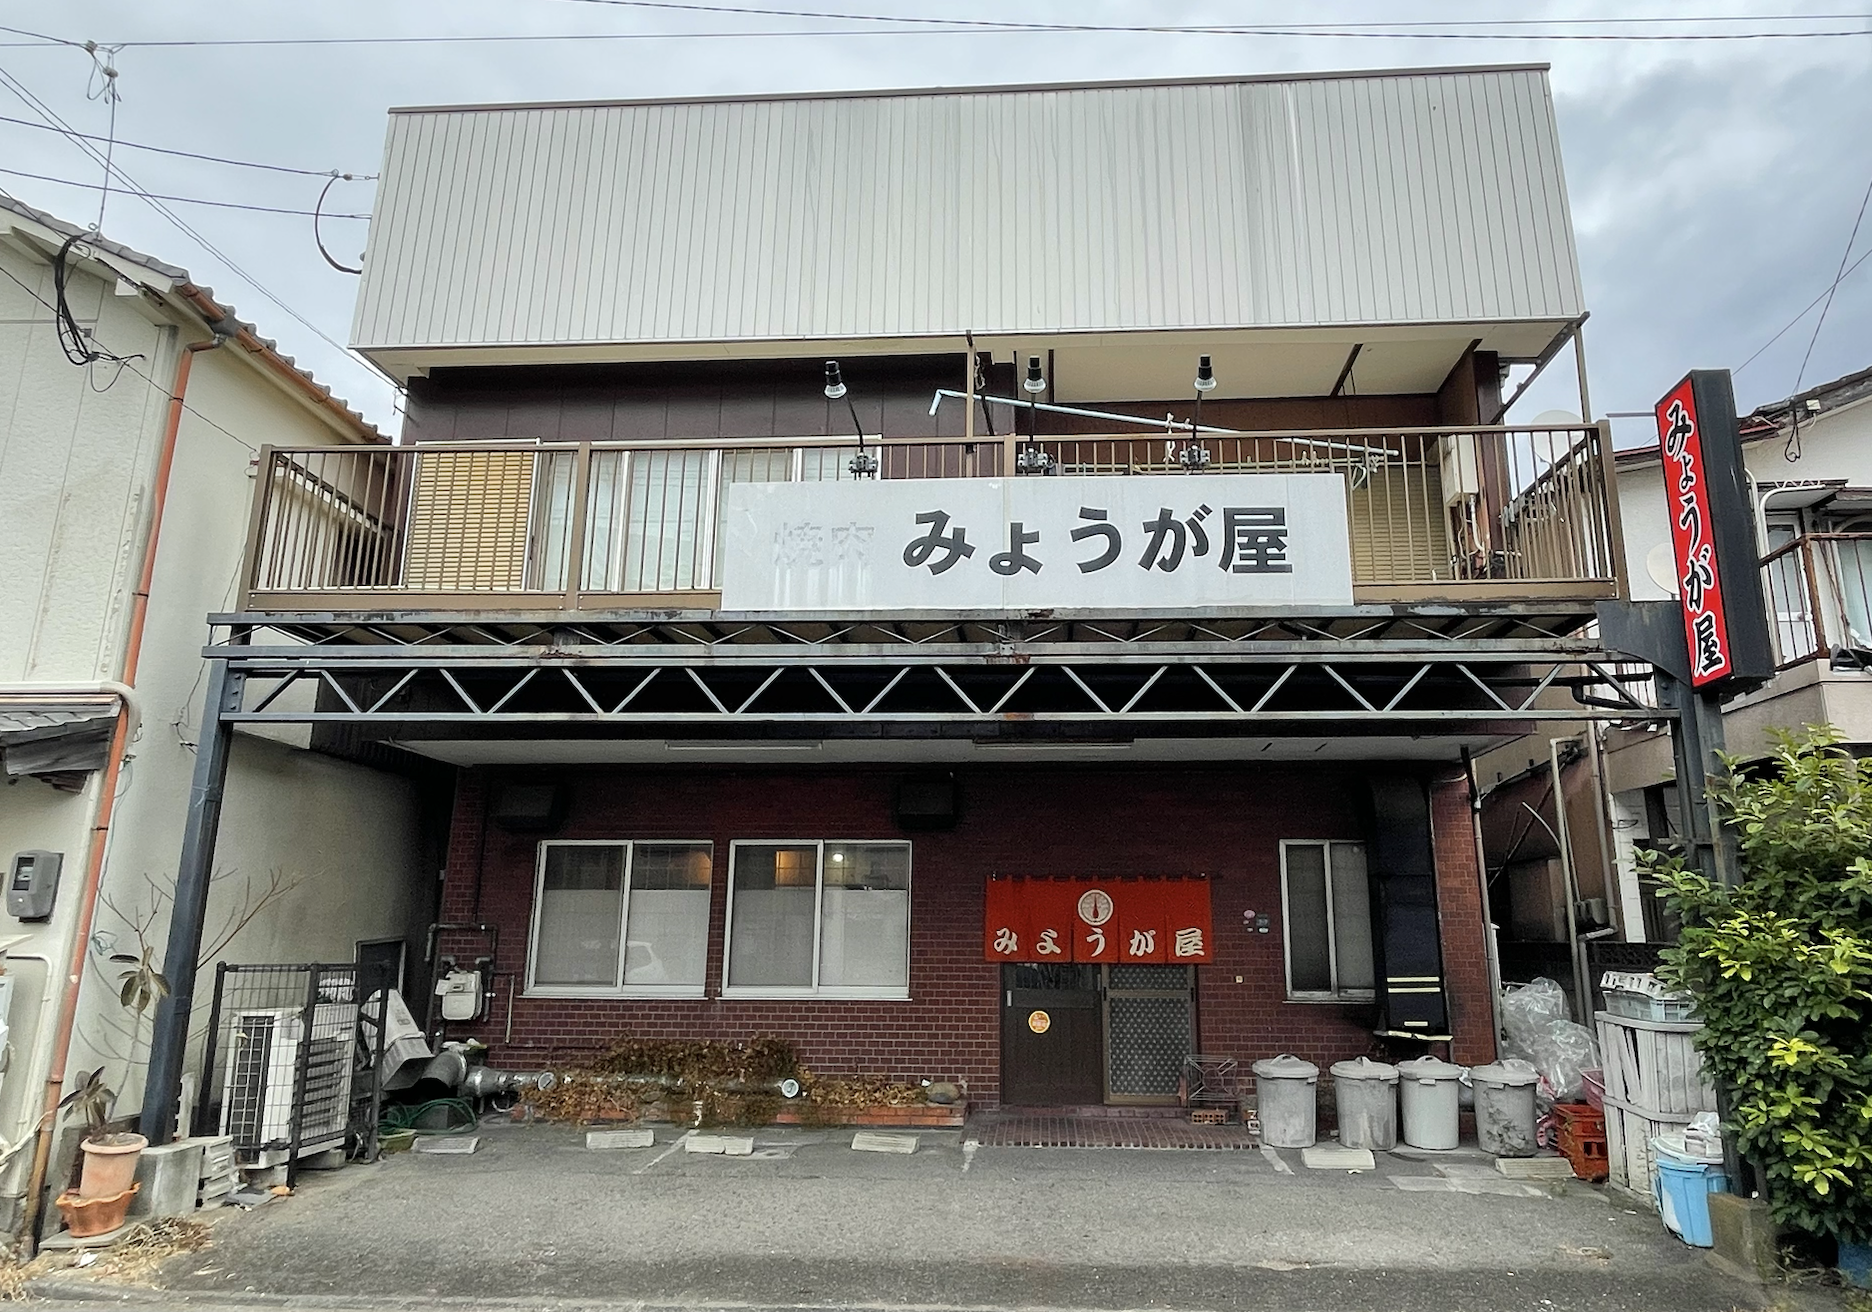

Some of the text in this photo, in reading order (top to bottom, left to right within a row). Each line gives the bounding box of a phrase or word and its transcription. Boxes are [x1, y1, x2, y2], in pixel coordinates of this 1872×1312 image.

[902, 503, 1293, 576] みょうが屋
[1665, 399, 1725, 678] みょうが屋
